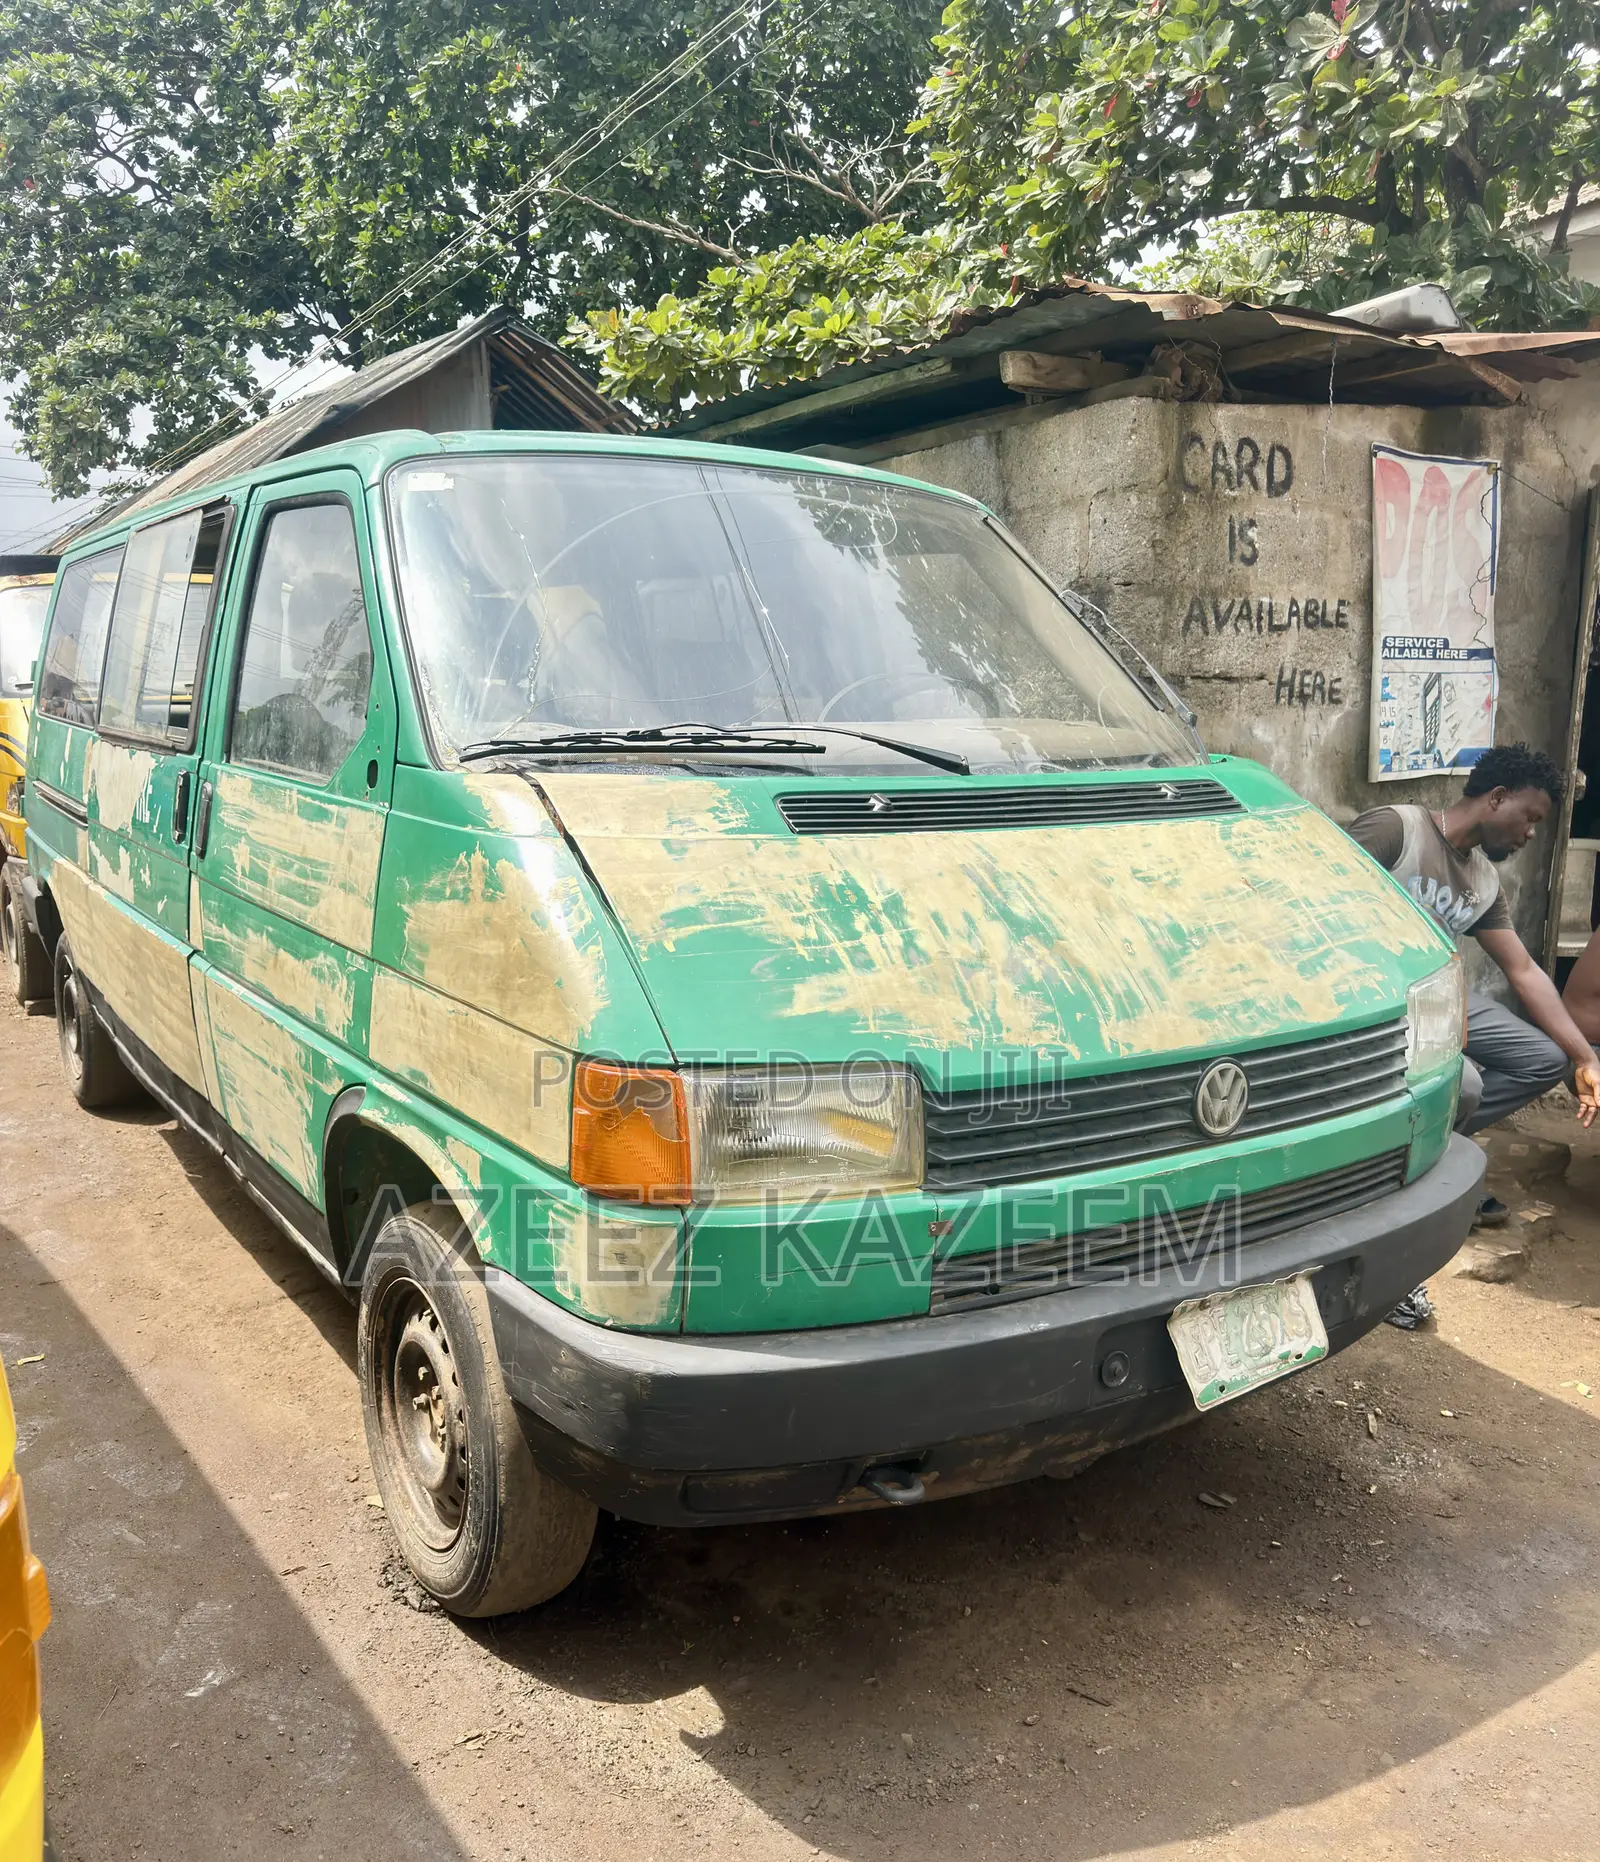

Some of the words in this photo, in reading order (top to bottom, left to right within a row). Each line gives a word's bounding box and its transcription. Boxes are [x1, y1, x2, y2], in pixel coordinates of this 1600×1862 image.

[1176, 431, 1294, 499] CARD
[1228, 515, 1259, 567] IS
[1181, 594, 1350, 642] AVAILABLE
[1385, 637, 1445, 648] SERVICE
[1435, 649, 1469, 659] HERE
[1275, 661, 1344, 706] HERE
